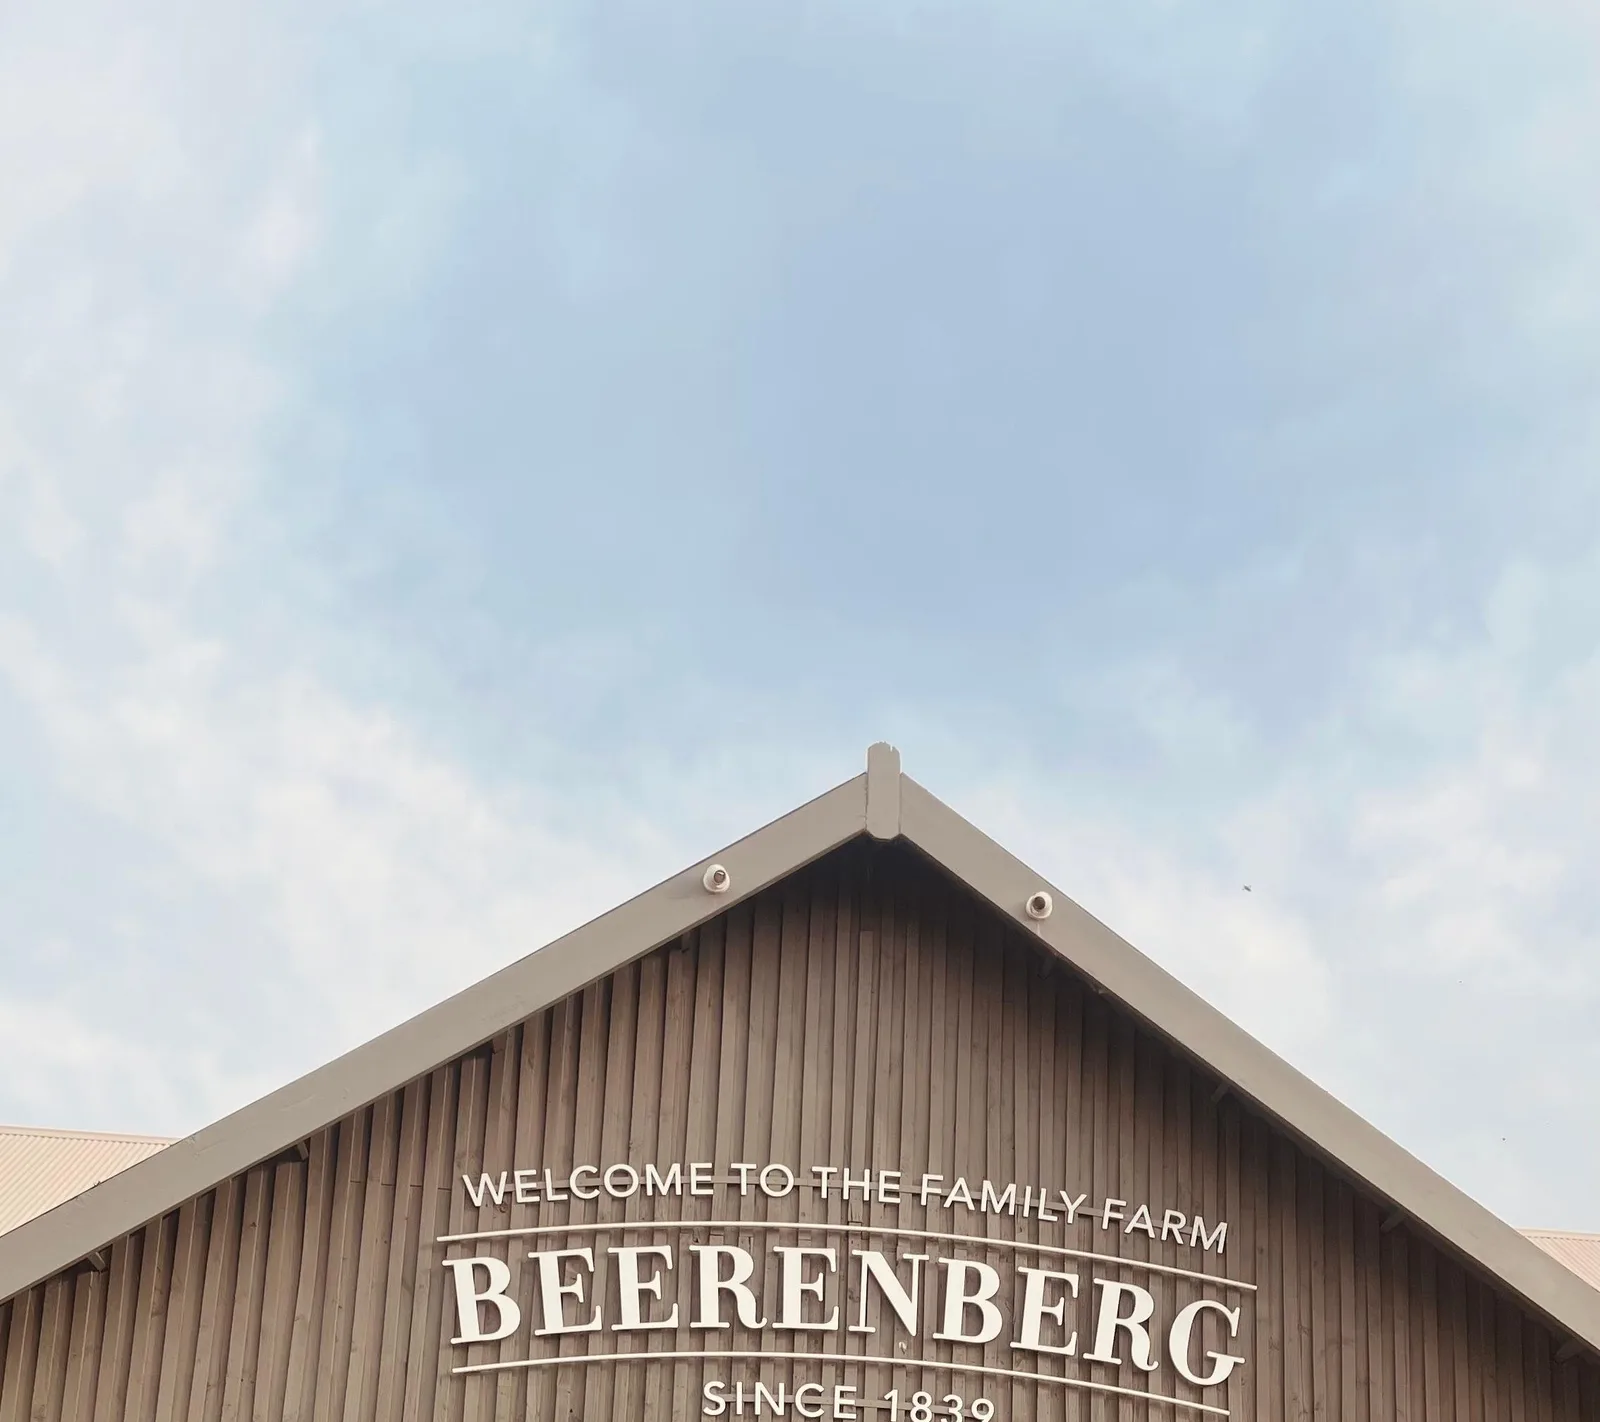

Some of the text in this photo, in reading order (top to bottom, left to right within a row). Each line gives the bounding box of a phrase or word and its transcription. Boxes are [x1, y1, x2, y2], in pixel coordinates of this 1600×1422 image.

[462, 1162, 1229, 1254] WELCOME TO THE FAMILY FARM
[441, 1244, 1246, 1387] BEERENBERG
[702, 1380, 857, 1420] SINCE
